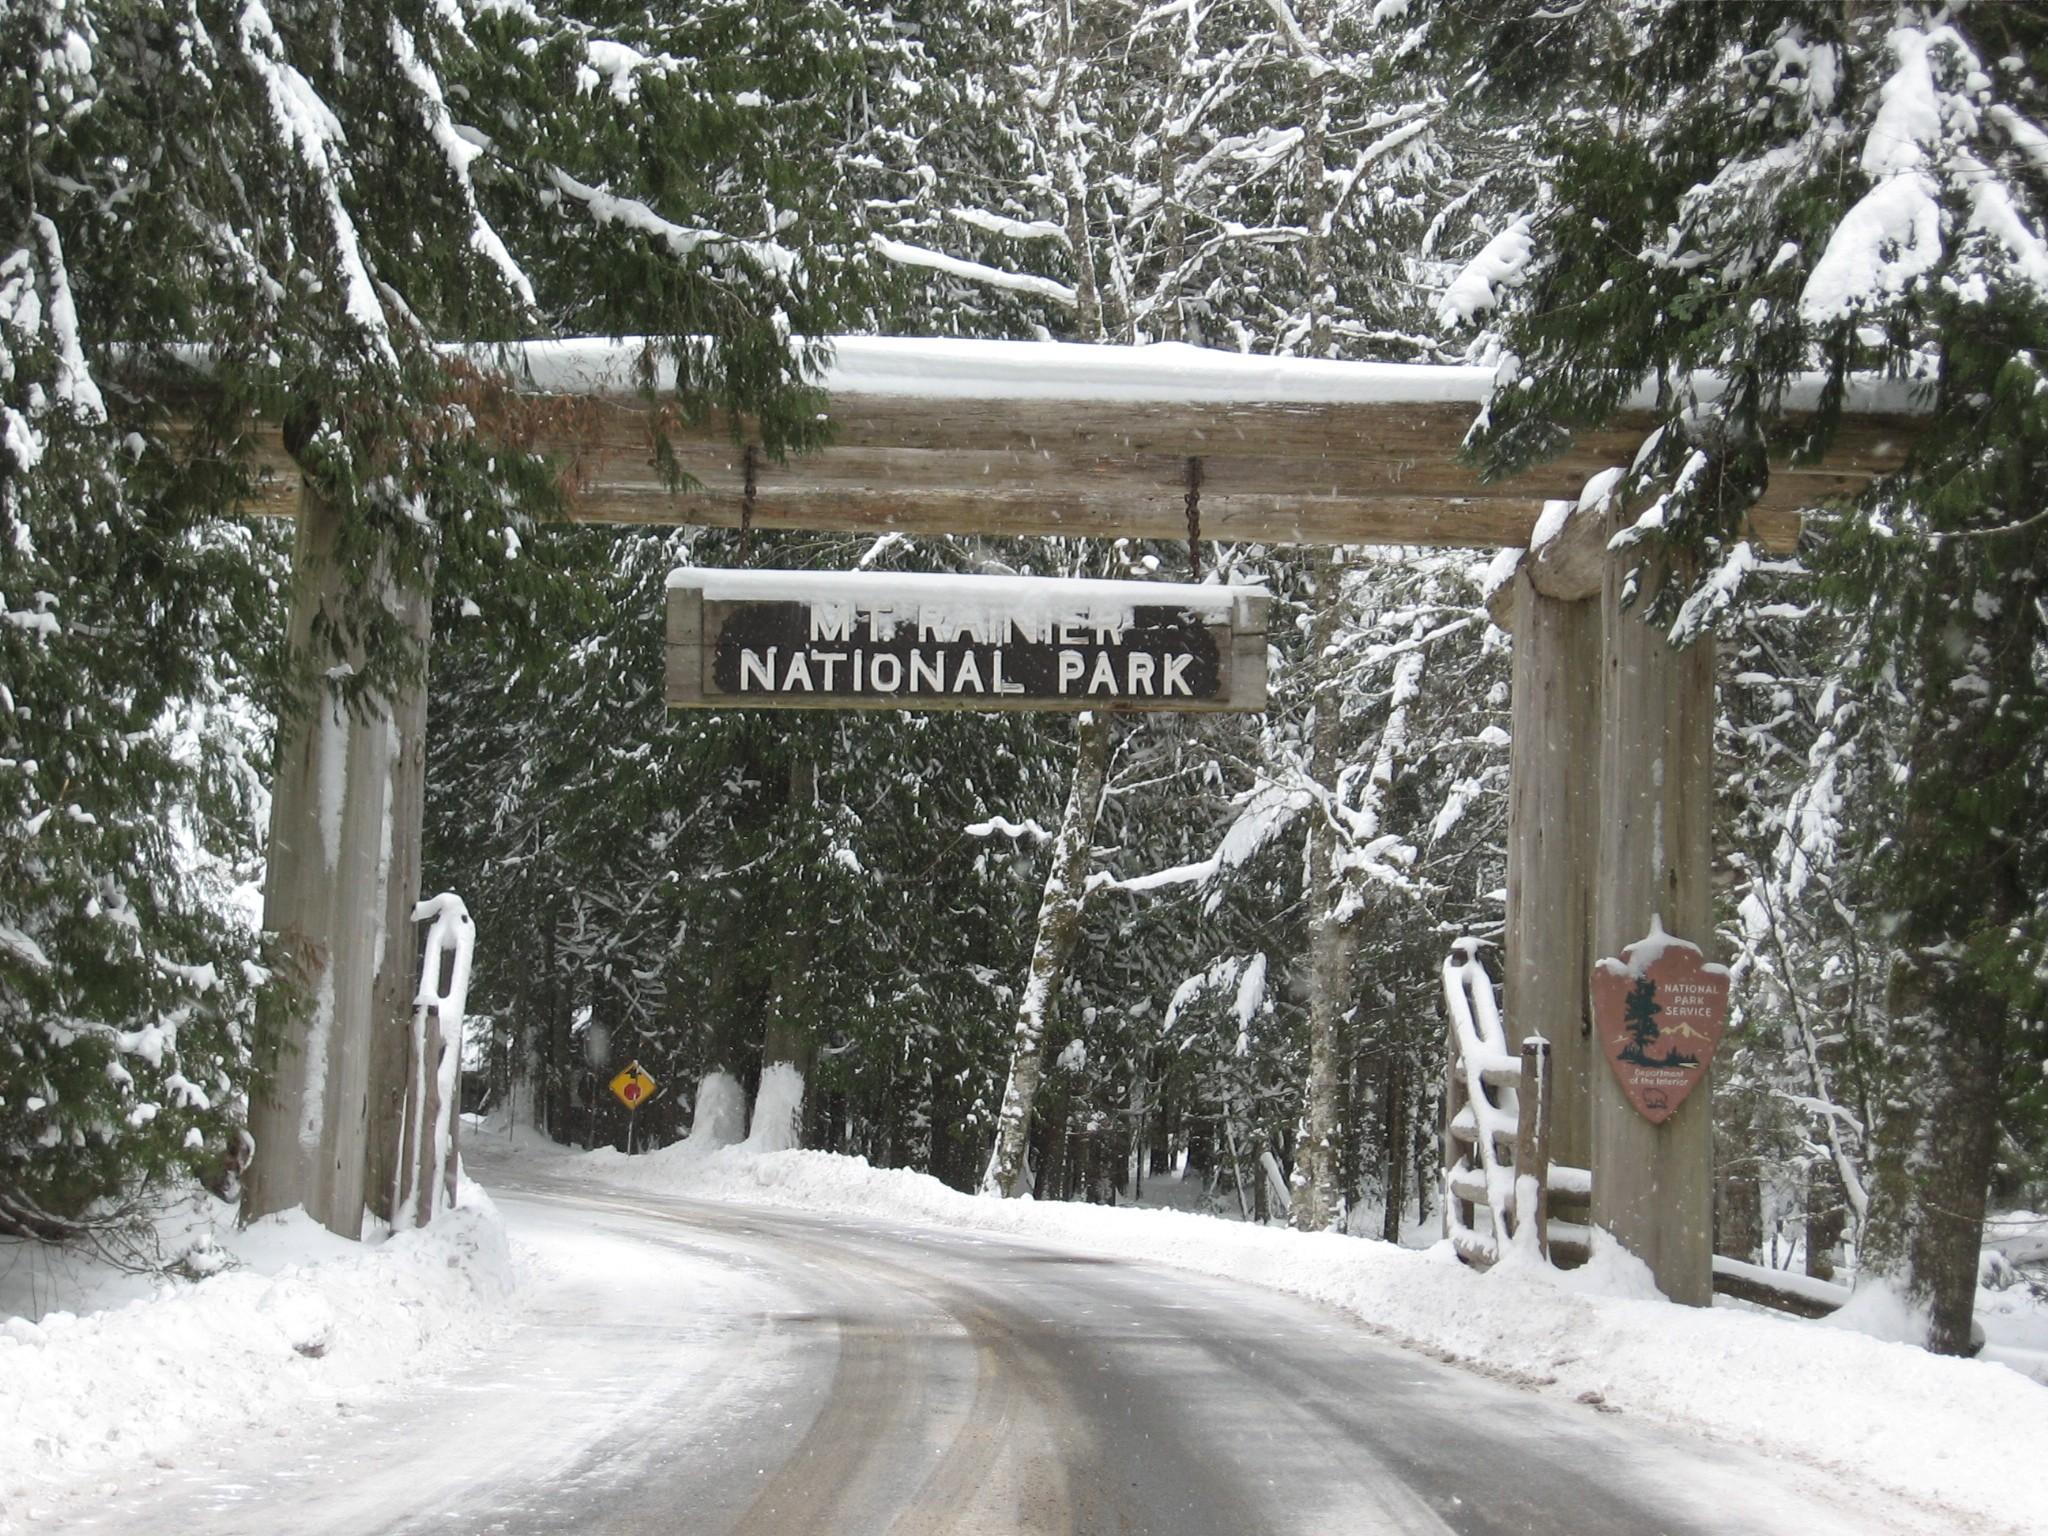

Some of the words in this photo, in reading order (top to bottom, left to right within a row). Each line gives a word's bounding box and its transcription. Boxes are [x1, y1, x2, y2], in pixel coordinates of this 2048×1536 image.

[740, 647, 1026, 694] NATIONAL
[1058, 652, 1196, 696] PARK
[1664, 984, 1719, 994] NATIONAL
[1674, 996, 1704, 1006] PARK
[1665, 1006, 1712, 1017] SERVICE
[1630, 1077, 1639, 1086] of
[1641, 1077, 1654, 1086] the
[1656, 1078, 1688, 1087] Interior
